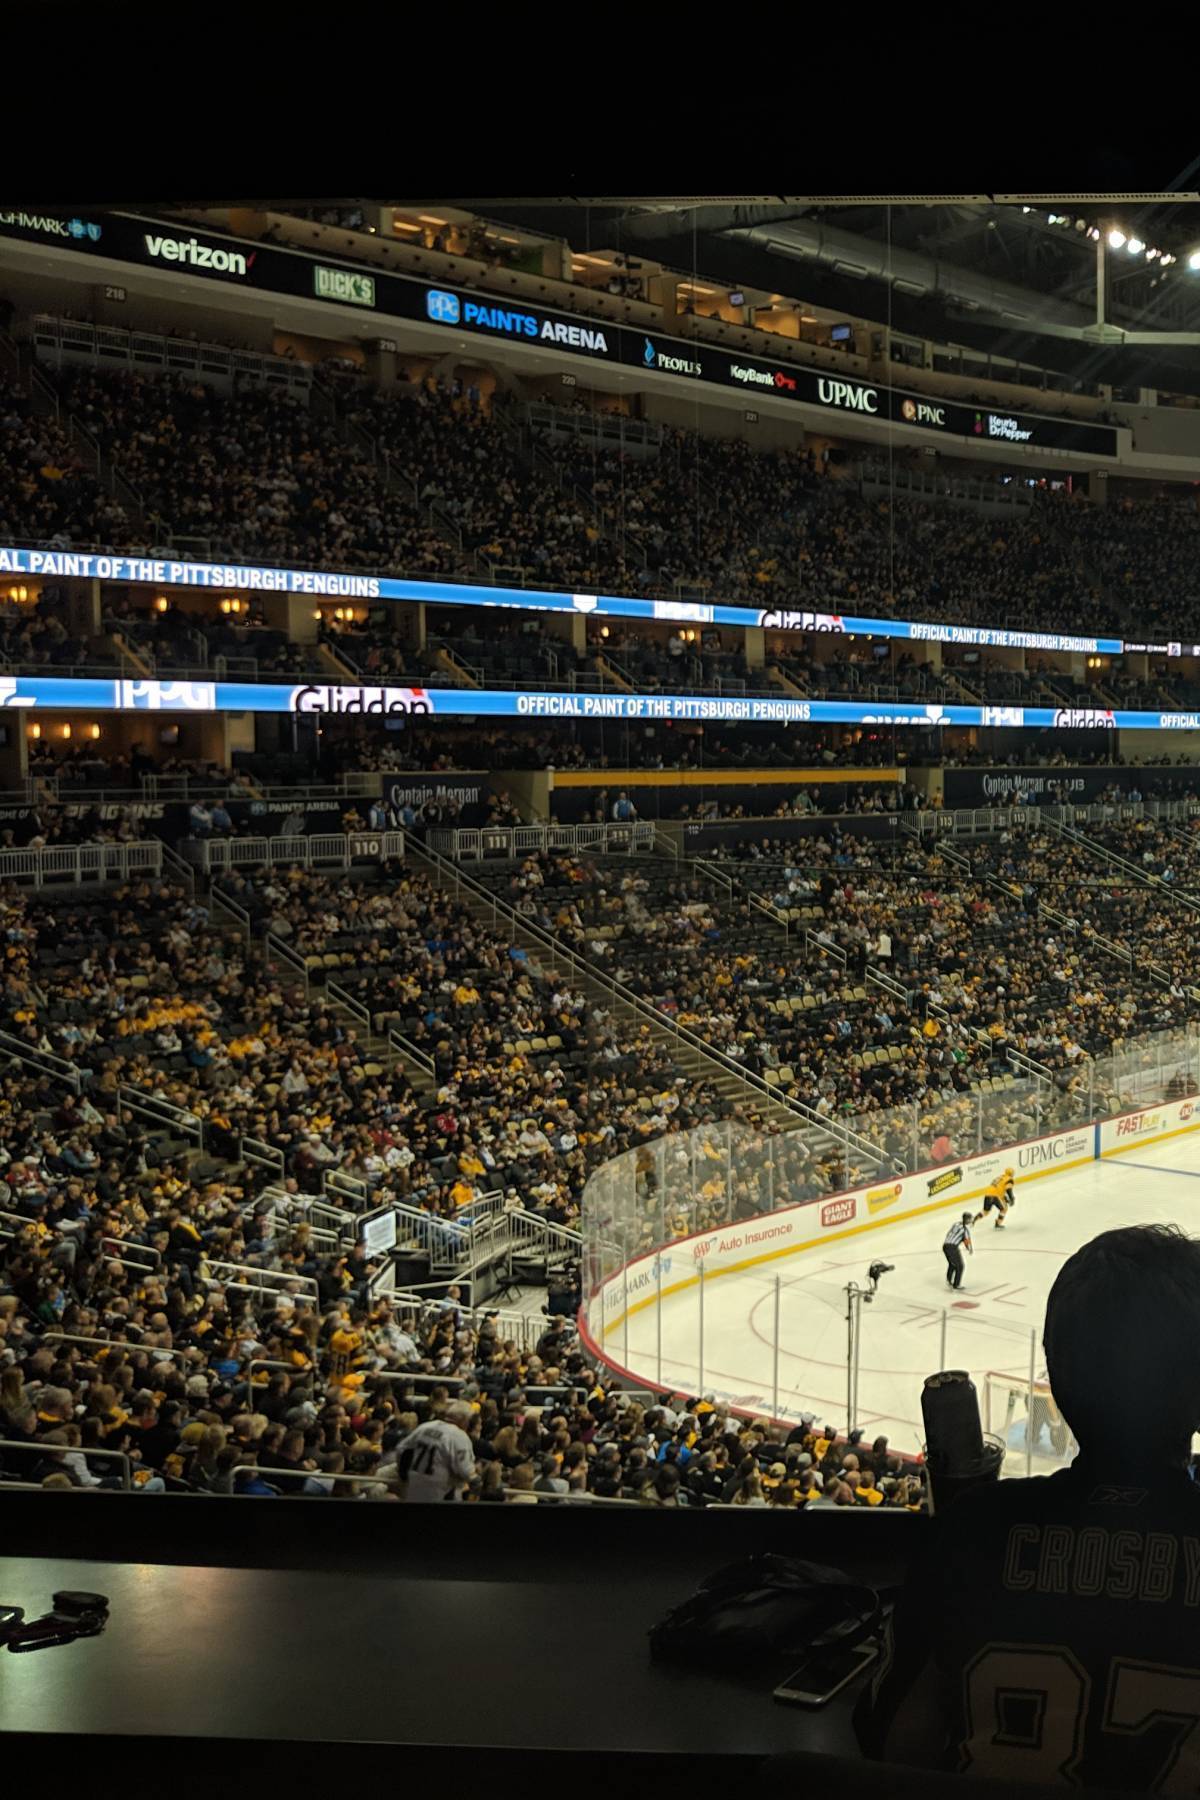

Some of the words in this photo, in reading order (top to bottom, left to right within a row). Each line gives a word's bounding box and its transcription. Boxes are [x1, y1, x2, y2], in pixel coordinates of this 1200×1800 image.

[145, 234, 247, 275] verizon
[318, 269, 372, 300] DICK'S
[465, 302, 538, 336] PAINTS
[541, 320, 608, 352] ARENA
[731, 364, 775, 387] KeyBank
[818, 379, 878, 413] UPMC
[918, 404, 946, 425] PNC
[989, 414, 1018, 431] Keurig
[30, 554, 93, 578] PAINT
[97, 559, 122, 579] OF
[126, 561, 166, 583] THE
[170, 563, 288, 592] PITTSBURGH
[291, 572, 381, 598] PENGUINS
[910, 623, 951, 642] OFFICIAL
[952, 625, 978, 644] PAINT
[979, 627, 991, 645] OF
[992, 628, 1008, 646] THE
[1009, 629, 1058, 650] PITTSBURGH
[1059, 633, 1098, 652] PENGUINS
[295, 685, 431, 714] Glidden
[517, 695, 582, 714] OFFICIAL
[585, 698, 624, 716] PAINT
[627, 699, 646, 716] OF
[647, 700, 672, 717] THE
[674, 701, 750, 718] PITTSBURGH
[753, 702, 810, 720] PENGUINS
[1057, 710, 1115, 728] Glidden
[1160, 714, 1200, 728] OFFICIAL
[390, 784, 433, 806] Captain
[436, 784, 478, 803] Morgan
[983, 774, 1013, 798] Captain
[1015, 775, 1044, 793] Morgan
[1047, 779, 1086, 793] CUB
[267, 802, 304, 813] PAINTS
[306, 801, 341, 812] ARENA
[355, 841, 379, 855] 110
[488, 835, 507, 849] 111
[1116, 1116, 1144, 1137] FAST
[1017, 1138, 1065, 1169] UPMC
[824, 1203, 853, 1216] GIANT
[825, 1210, 852, 1224] EAGLE
[719, 1237, 742, 1252] Auto
[744, 1222, 794, 1245] Insurance
[412, 1443, 438, 1476] 71
